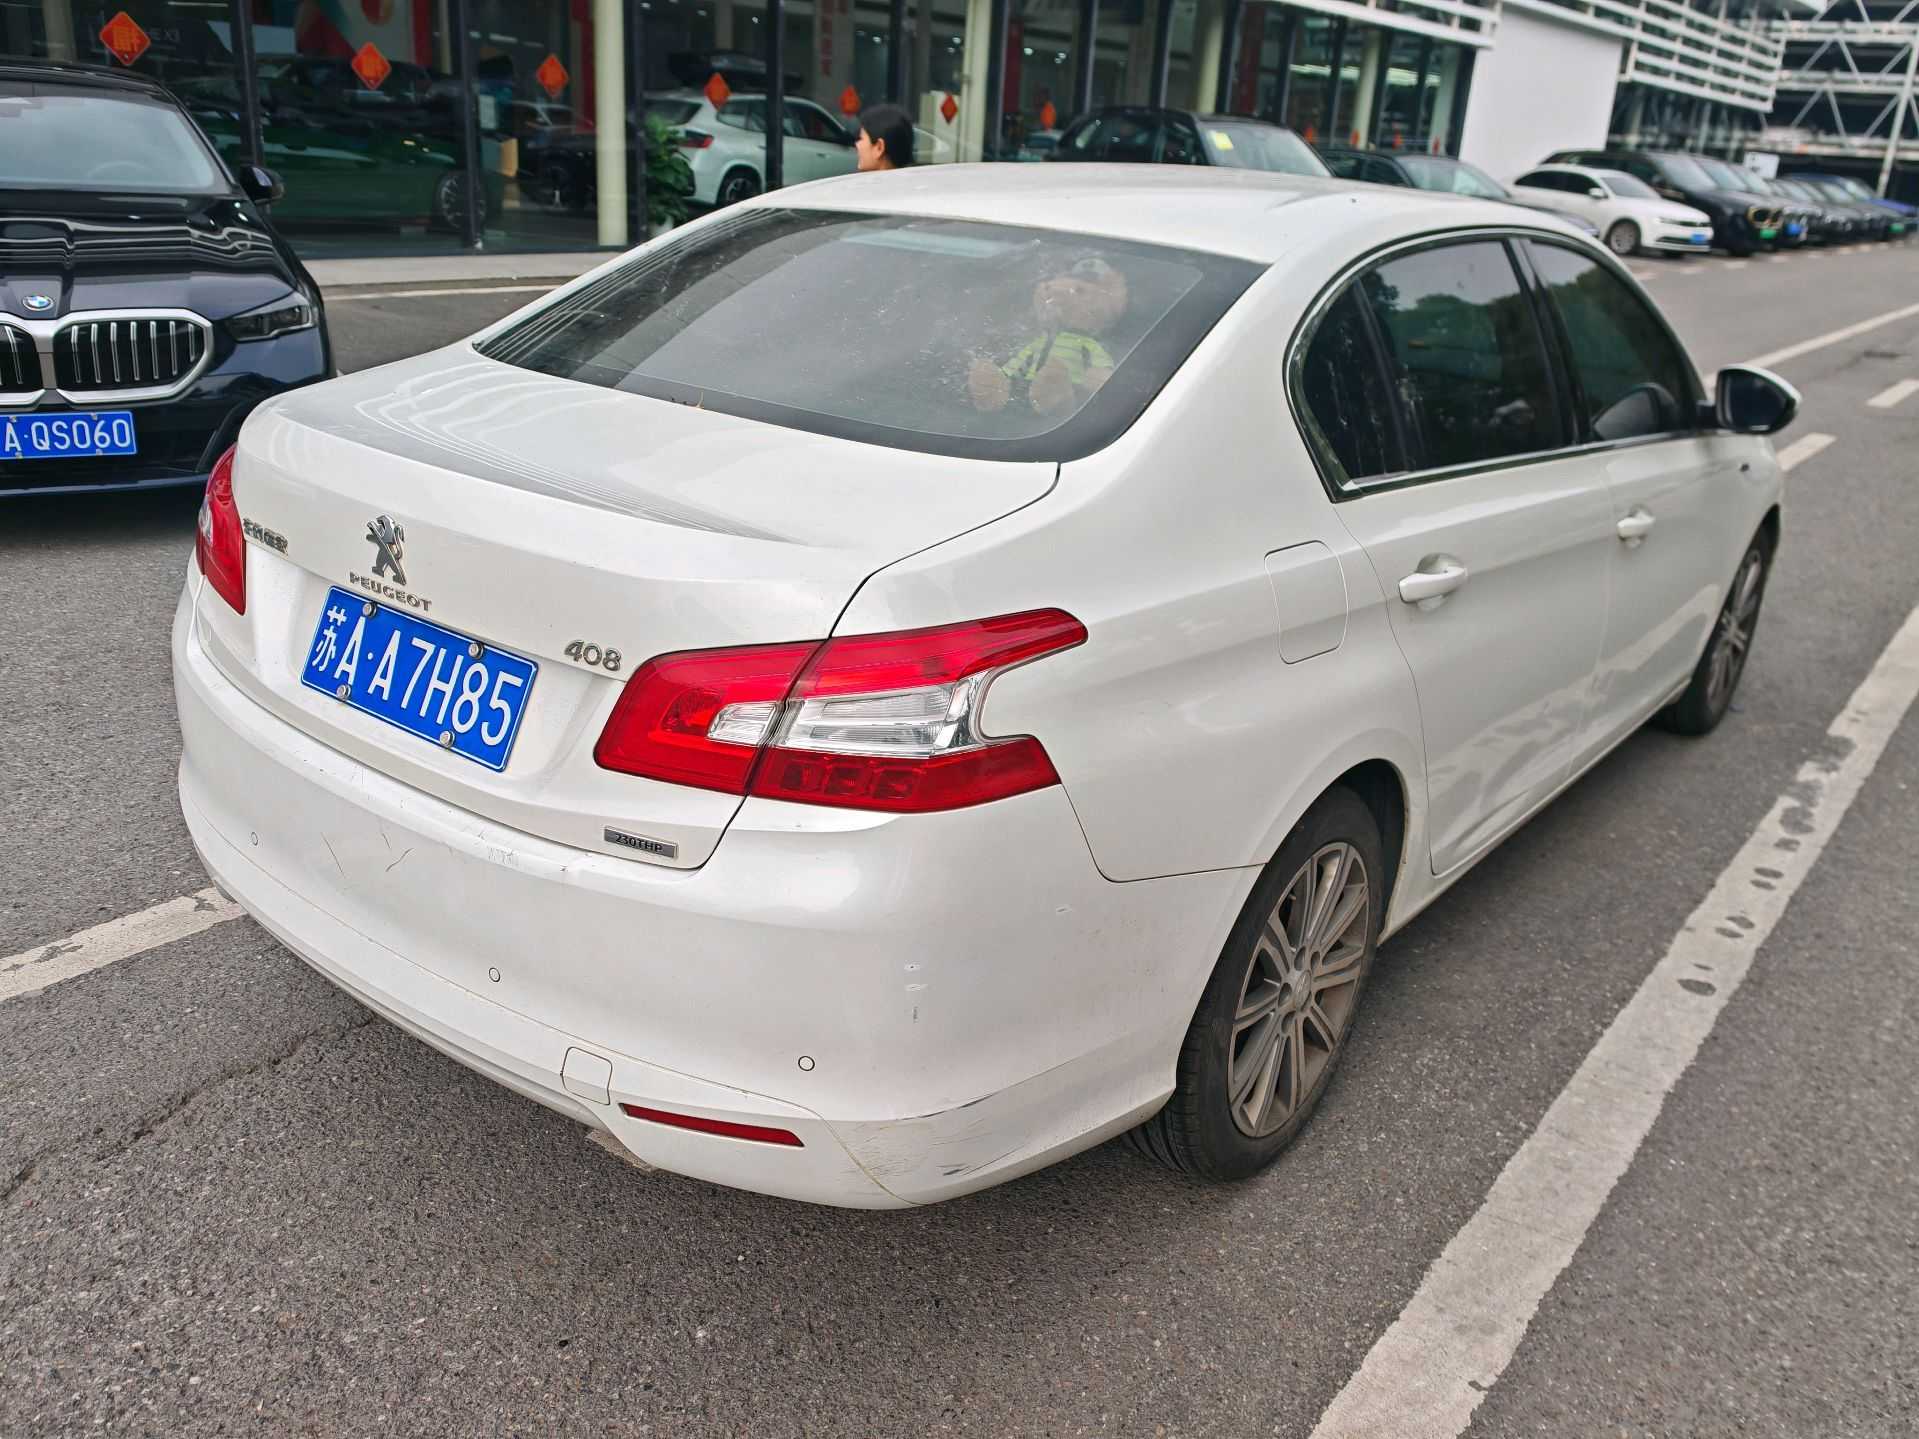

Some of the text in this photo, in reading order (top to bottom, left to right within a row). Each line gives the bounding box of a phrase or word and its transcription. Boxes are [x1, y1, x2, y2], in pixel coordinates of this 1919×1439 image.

[349, 571, 433, 611] PEUGEOT
[563, 639, 622, 672] 408
[311, 604, 524, 747] 苏A·A7H85
[614, 832, 665, 855] 230THP
